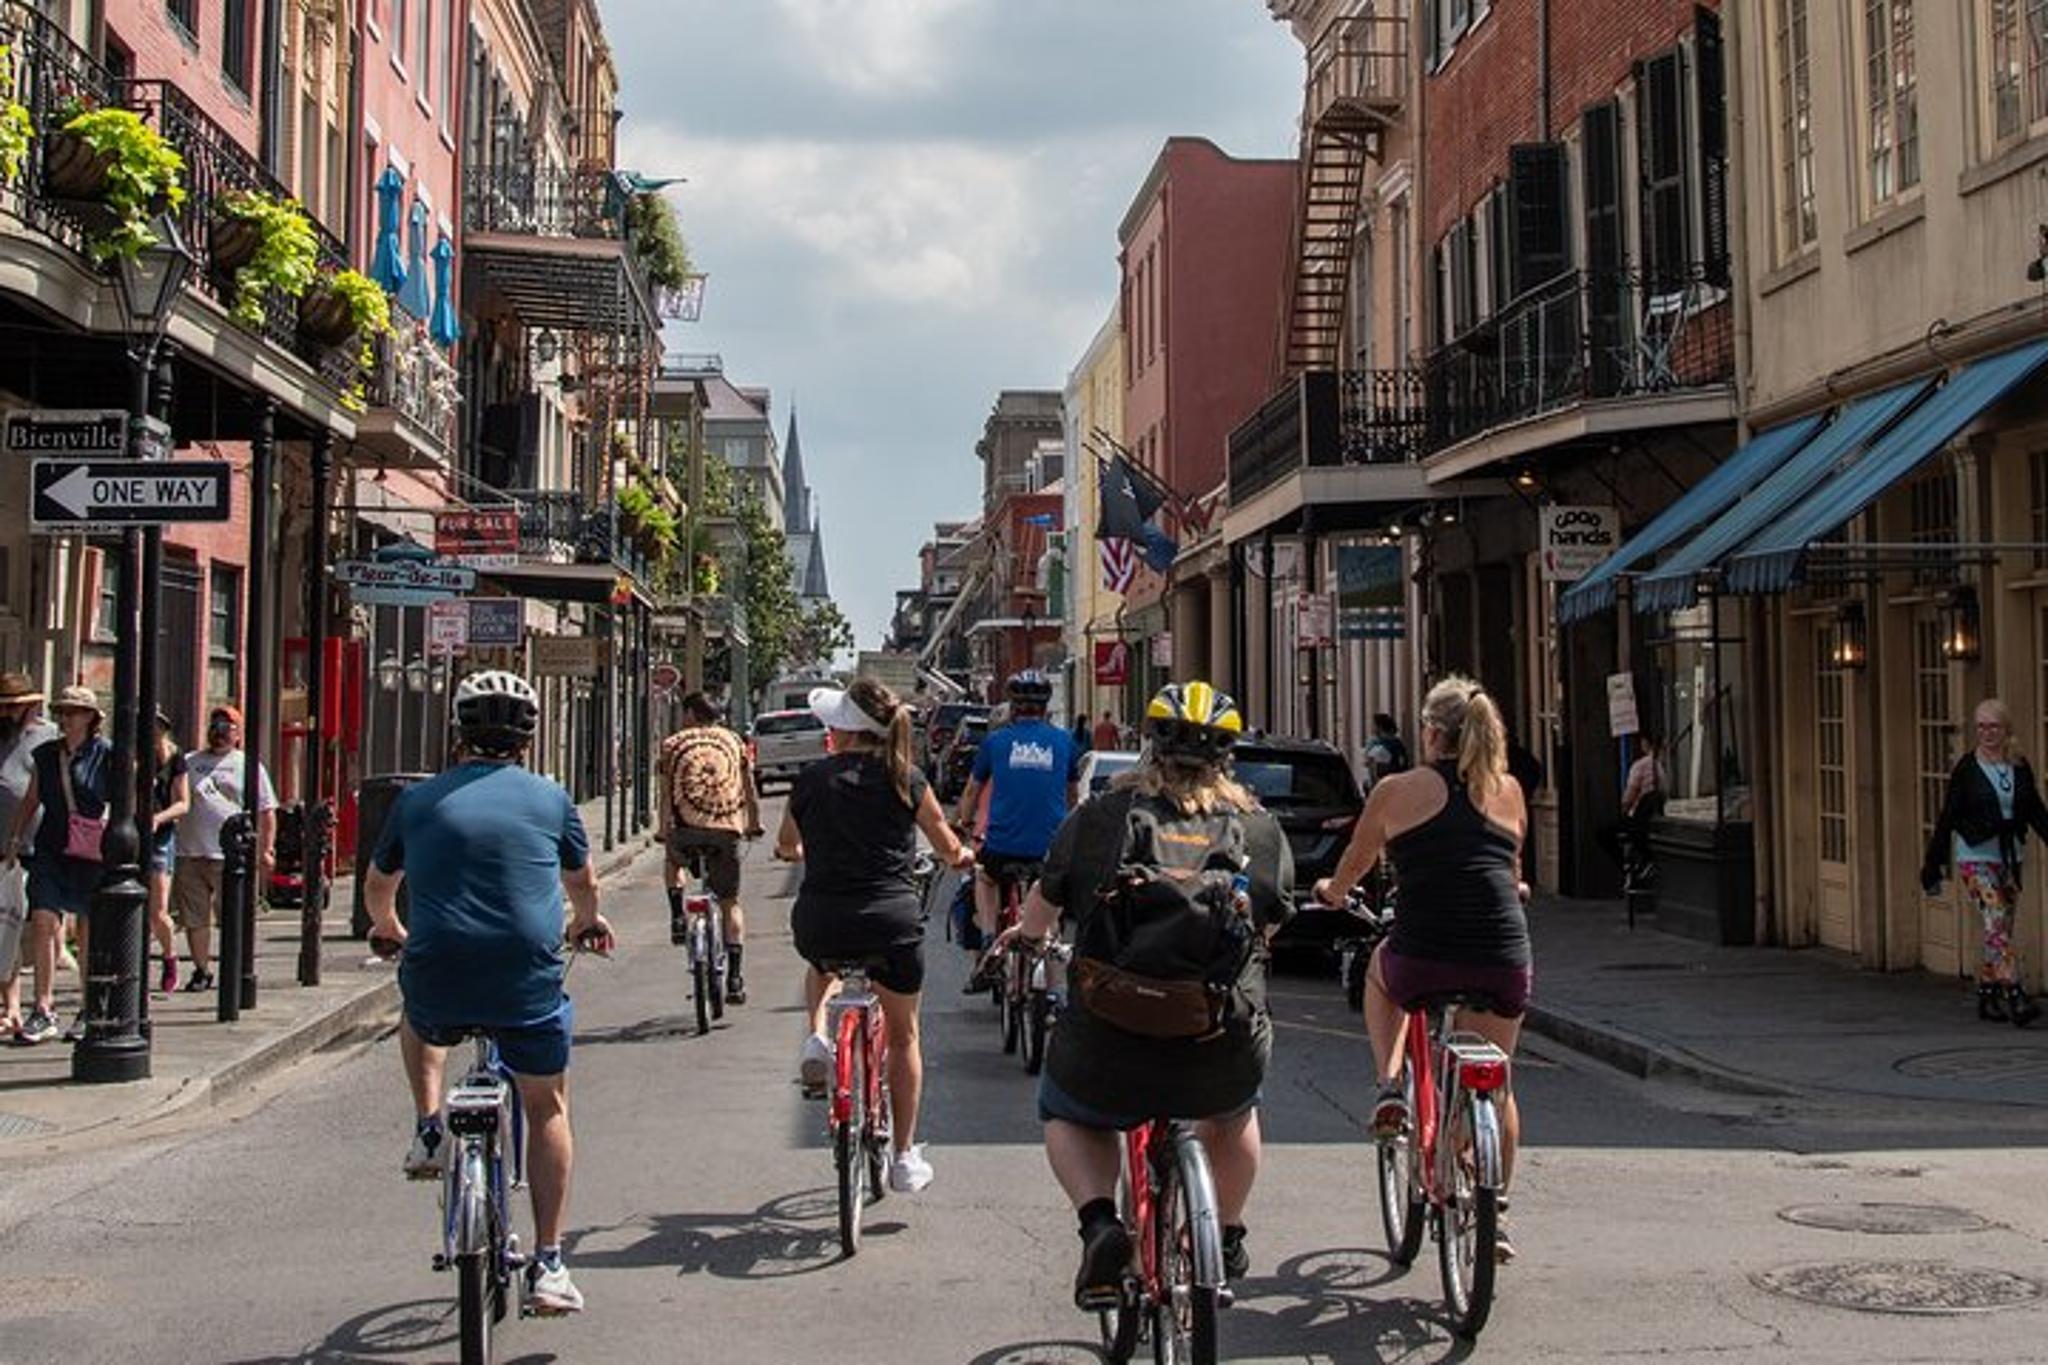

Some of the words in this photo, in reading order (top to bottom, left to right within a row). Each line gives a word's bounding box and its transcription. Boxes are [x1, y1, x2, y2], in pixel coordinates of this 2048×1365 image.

[10, 425, 121, 448] Bienville
[93, 480, 146, 503] ONE
[155, 480, 209, 503] WAY
[438, 516, 468, 531] FOR
[474, 516, 513, 530] SALE
[1550, 528, 1612, 545] hands
